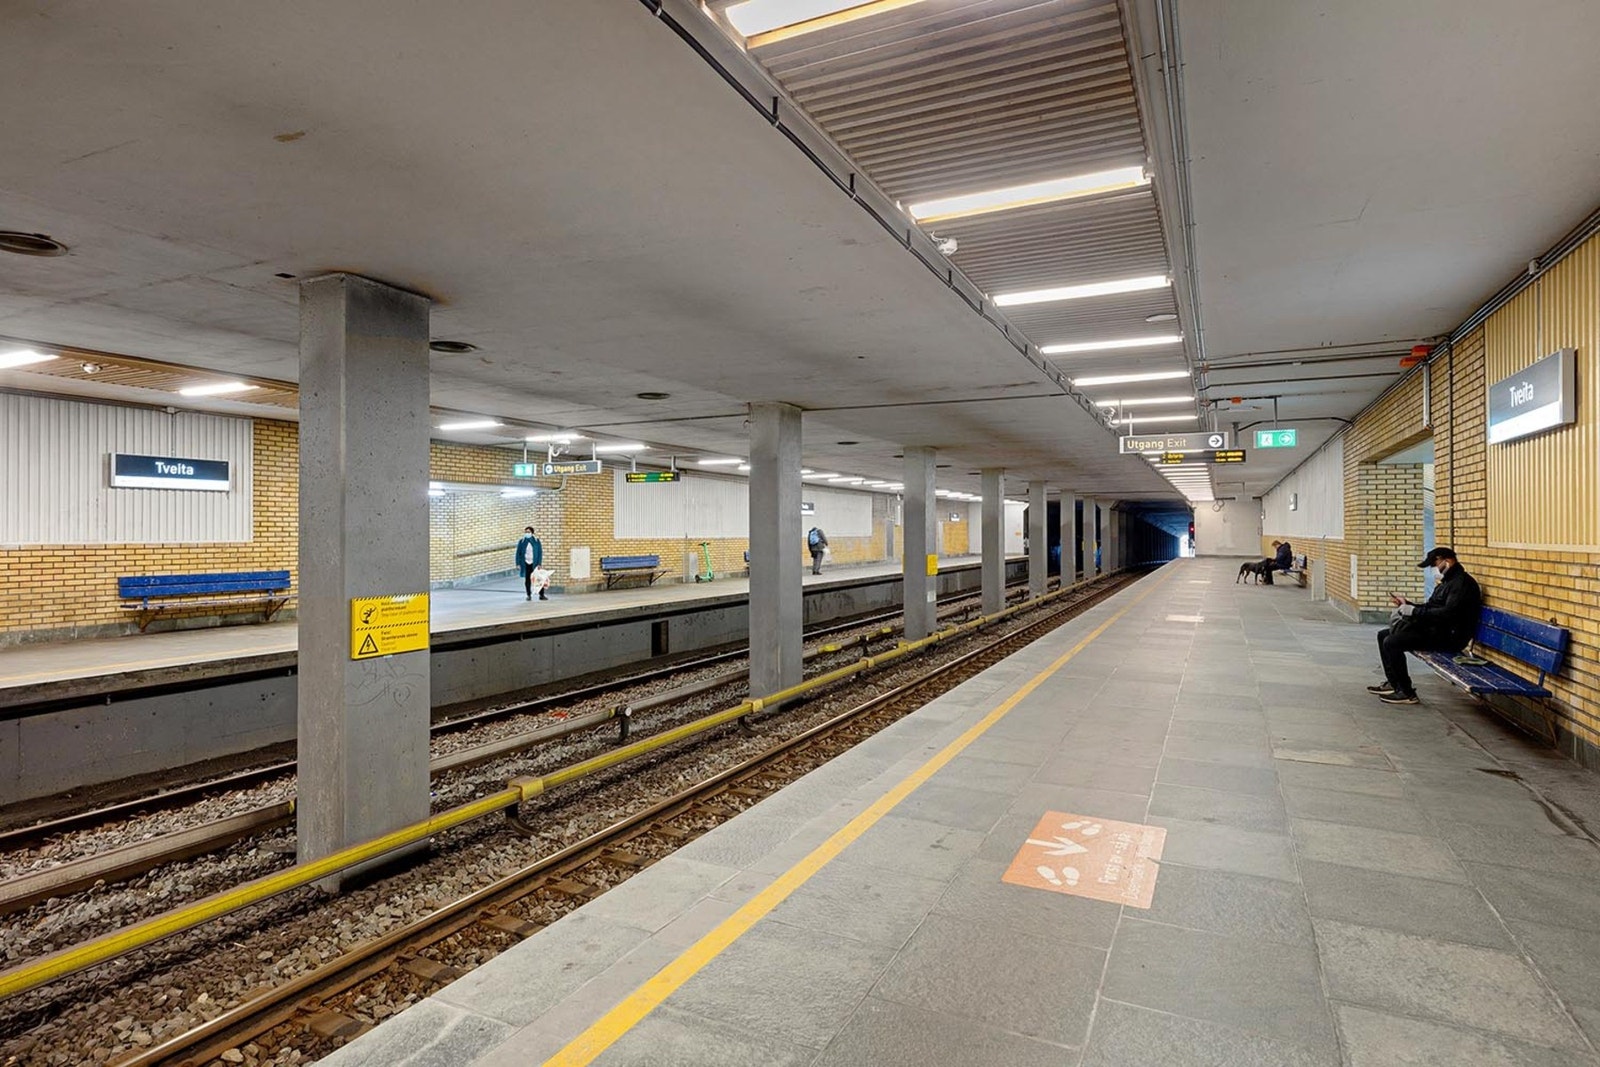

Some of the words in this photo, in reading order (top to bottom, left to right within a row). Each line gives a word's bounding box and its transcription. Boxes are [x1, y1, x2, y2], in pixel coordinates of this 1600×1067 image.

[1509, 381, 1534, 408] Tveita
[1127, 439, 1164, 450] Utgang
[1167, 438, 1187, 448] Exit
[155, 461, 194, 475] Tveita
[553, 464, 575, 474] Utgang
[575, 463, 587, 472] Exit
